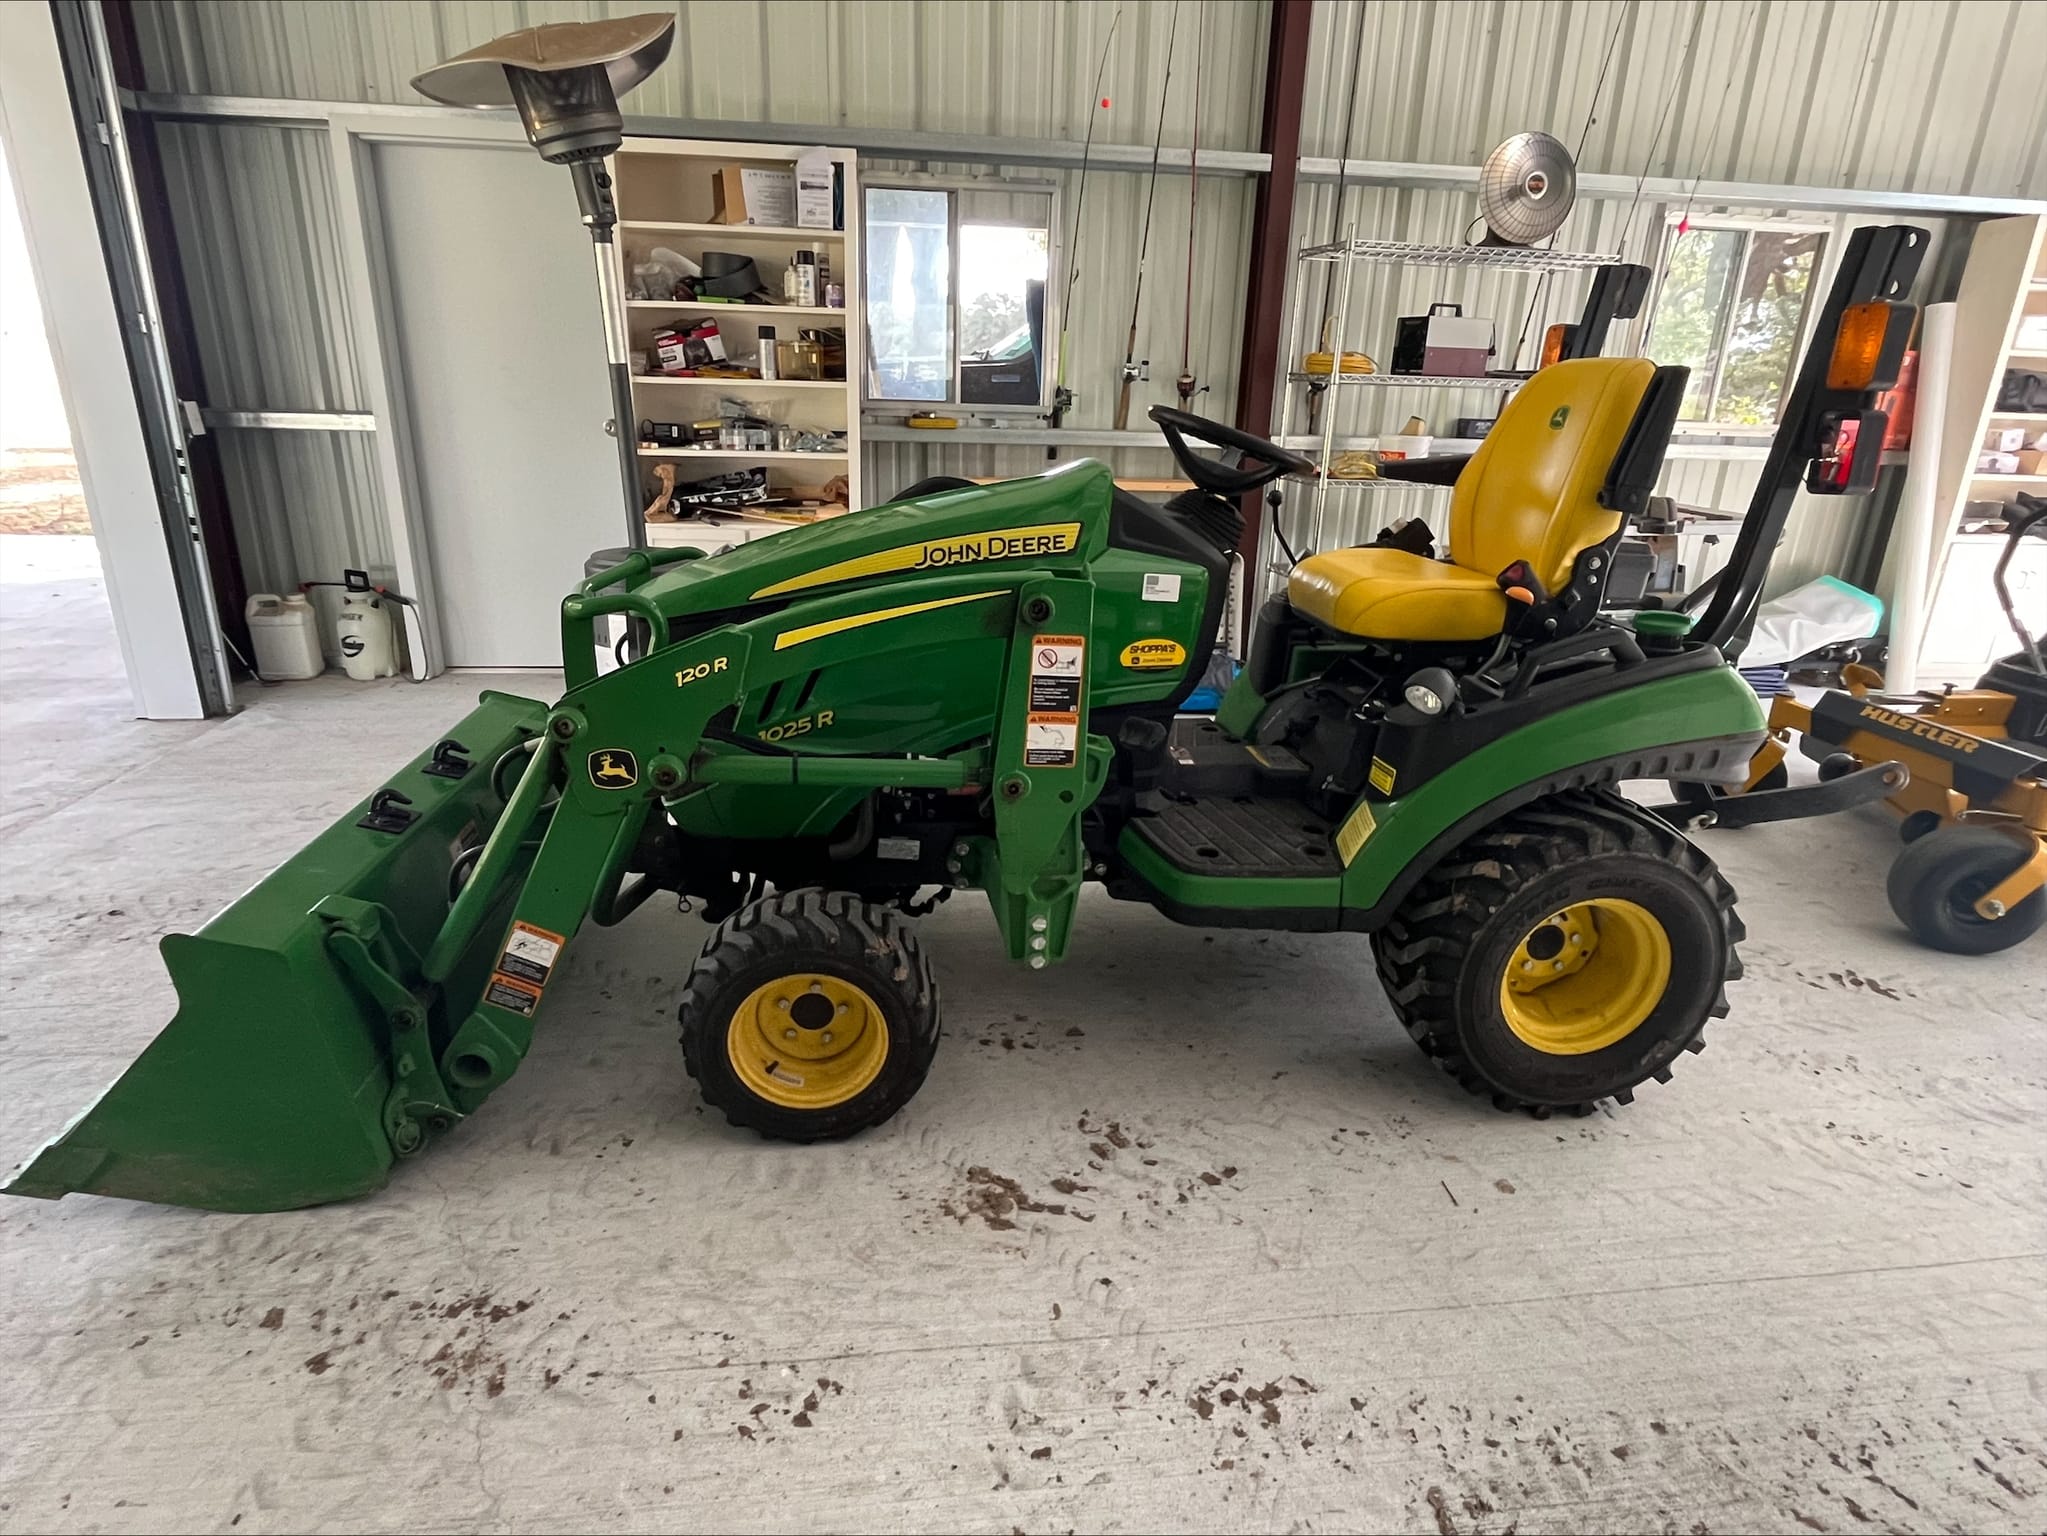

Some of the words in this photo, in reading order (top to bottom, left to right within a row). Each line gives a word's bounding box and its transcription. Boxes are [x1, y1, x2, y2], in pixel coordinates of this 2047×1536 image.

[914, 542, 982, 568] JOHN
[988, 534, 1067, 557] DEERE
[1130, 644, 1177, 654] SHOPPA'S
[675, 663, 710, 687] 120
[714, 657, 728, 673] R
[758, 717, 811, 741] 1025
[817, 710, 834, 729] R
[1859, 705, 1979, 753] HUSTLER
